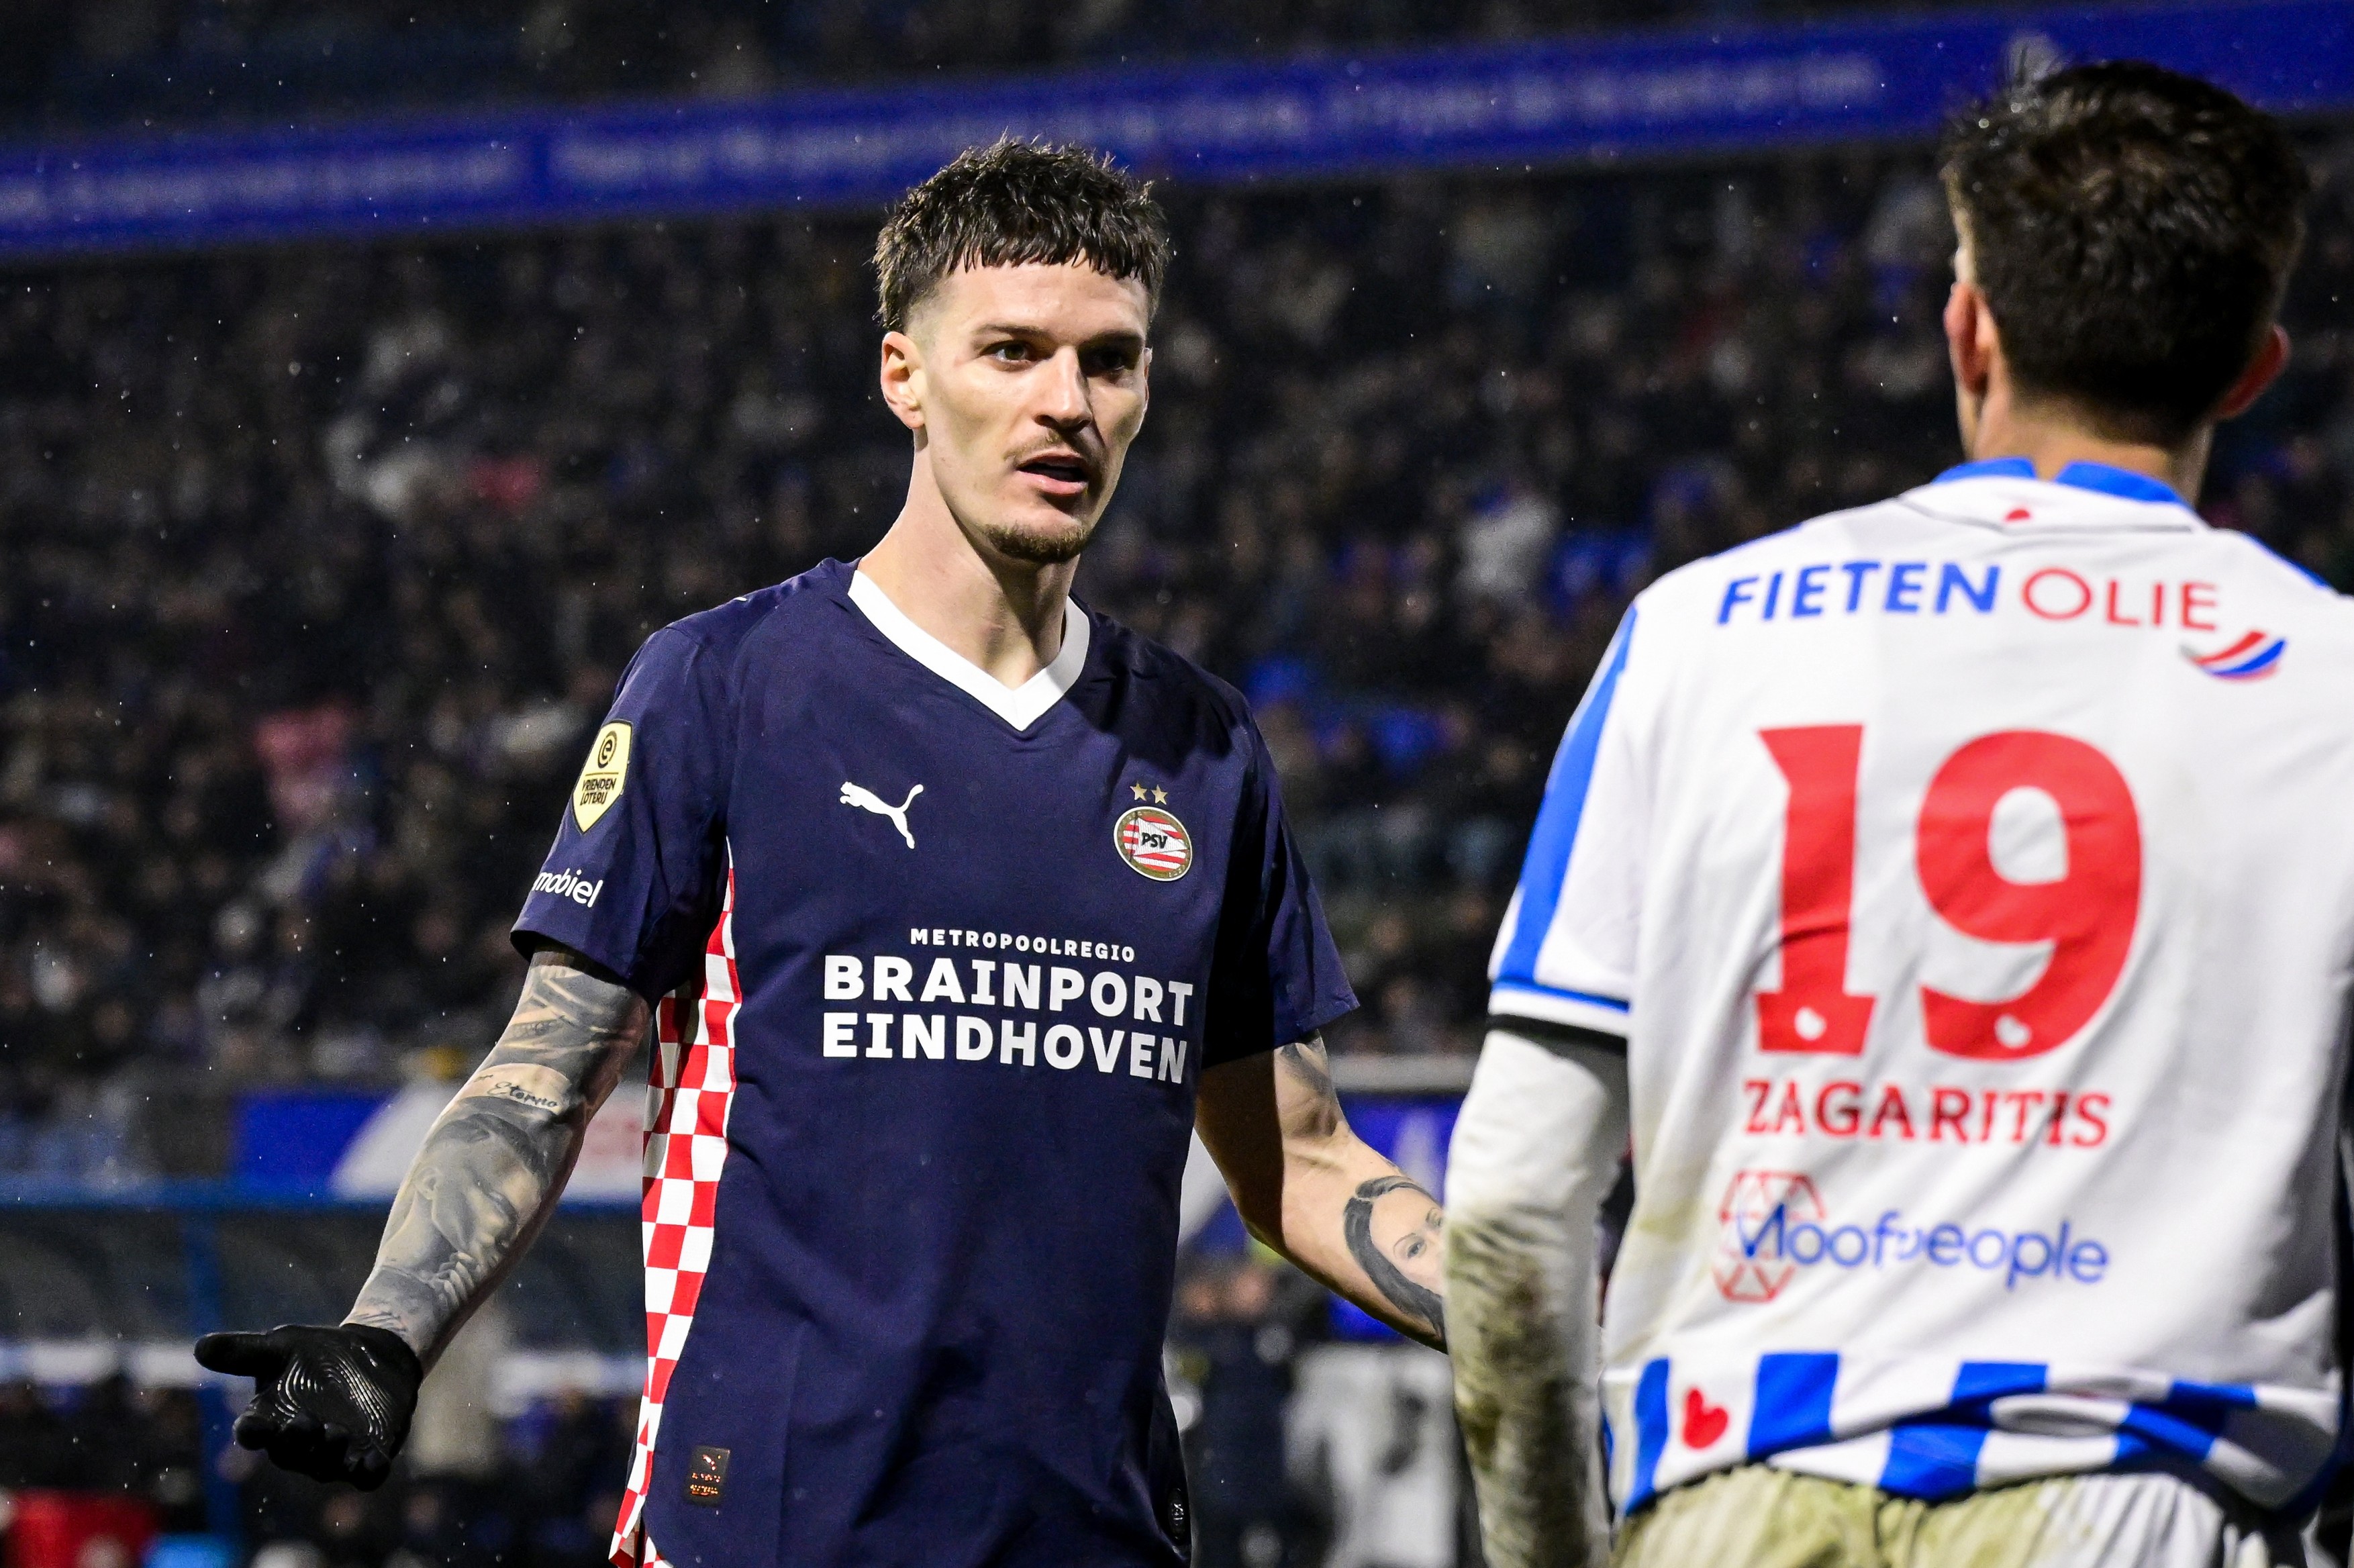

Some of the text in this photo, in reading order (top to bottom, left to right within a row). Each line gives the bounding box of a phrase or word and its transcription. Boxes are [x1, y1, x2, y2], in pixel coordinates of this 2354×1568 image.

[1717, 560, 2217, 632] FIETEN OLIE
[579, 791, 608, 806] LOTERIJ
[582, 778, 617, 791] VRIENDEN
[1141, 832, 1168, 849] PSV
[532, 867, 603, 908] mobiel
[1753, 723, 2145, 1064] 19
[910, 928, 1135, 963] METROPOOLREGIO
[824, 954, 1193, 1026] BRAINPORT
[823, 1012, 1187, 1084] EINDHOVEN
[1745, 1079, 2112, 1148] ZAGARITIS
